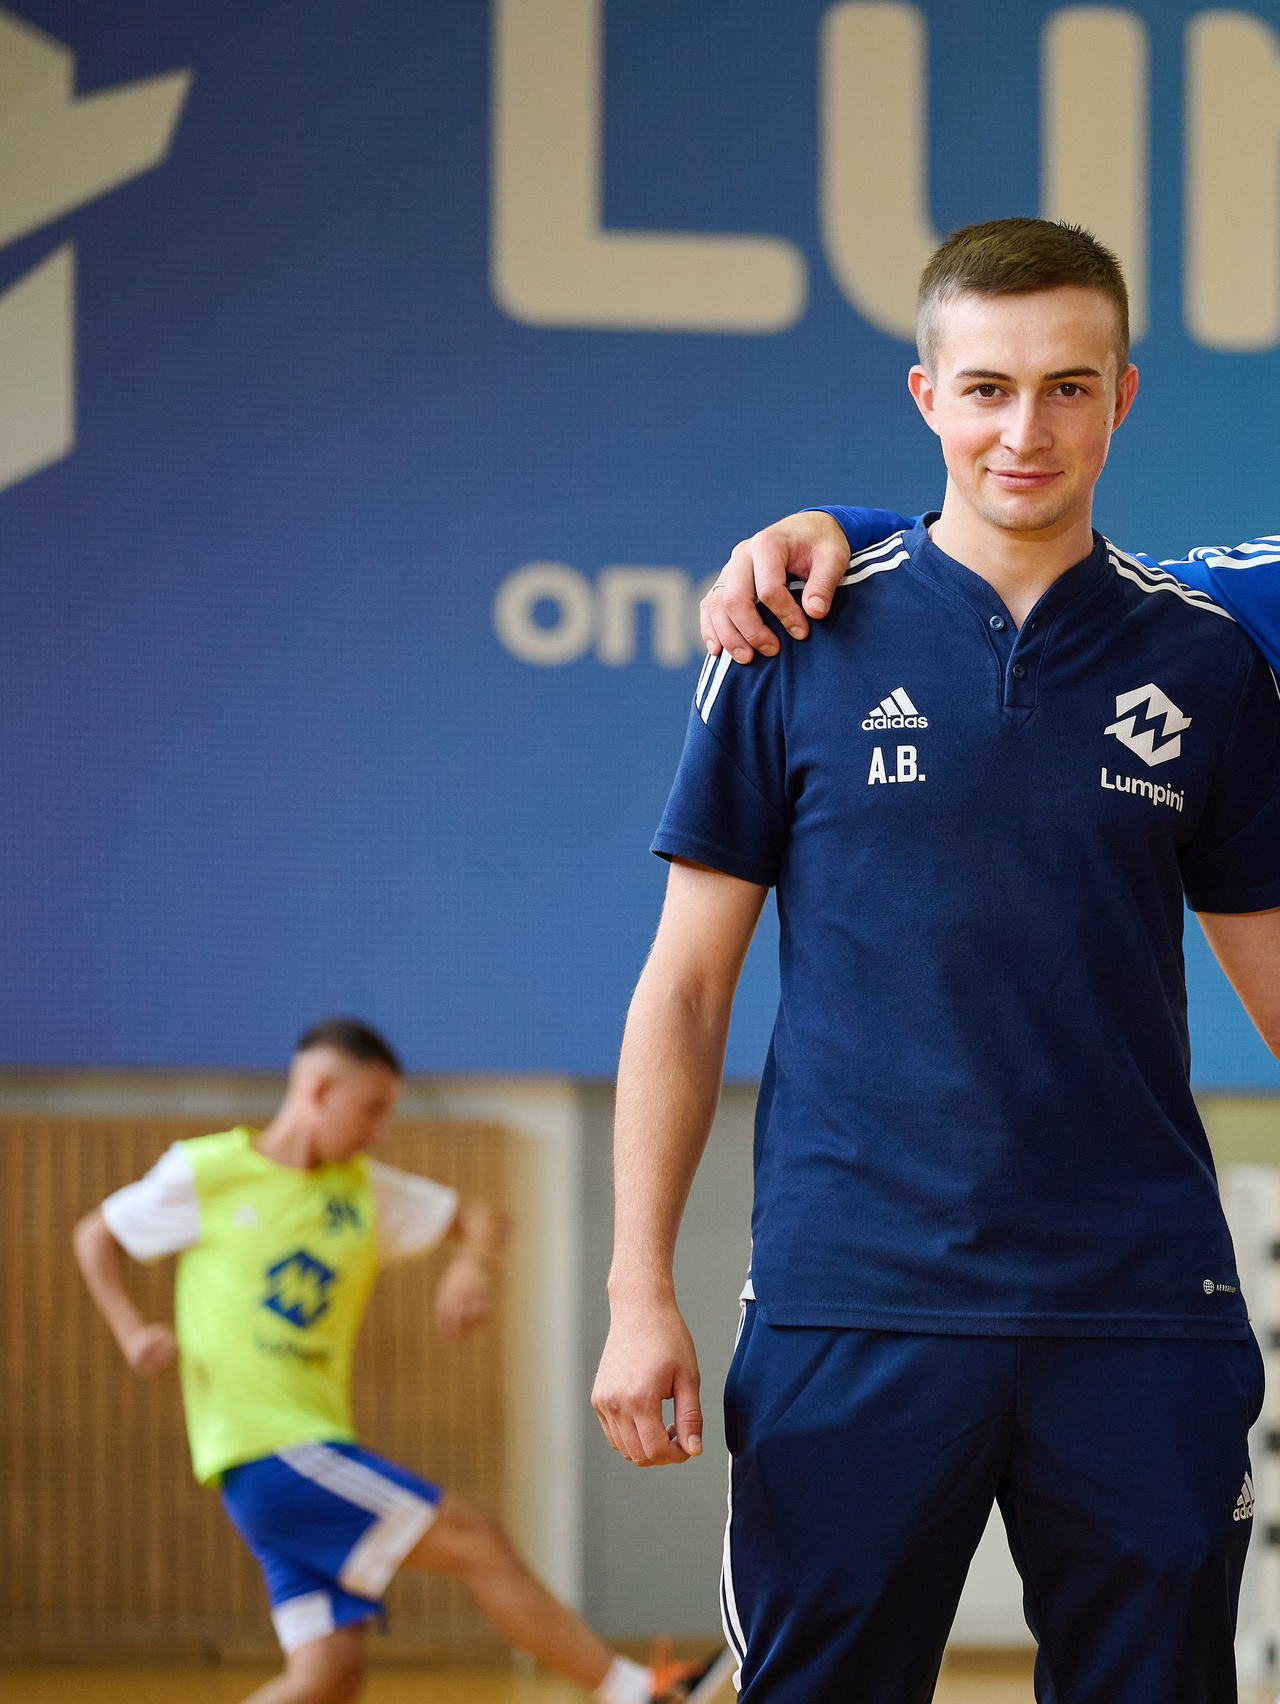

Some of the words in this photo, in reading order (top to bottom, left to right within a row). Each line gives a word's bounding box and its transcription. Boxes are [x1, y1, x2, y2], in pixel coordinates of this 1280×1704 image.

[861, 710, 928, 731] adidas
[1100, 766, 1186, 813] Lumpini
[1232, 1503, 1254, 1521] adid
